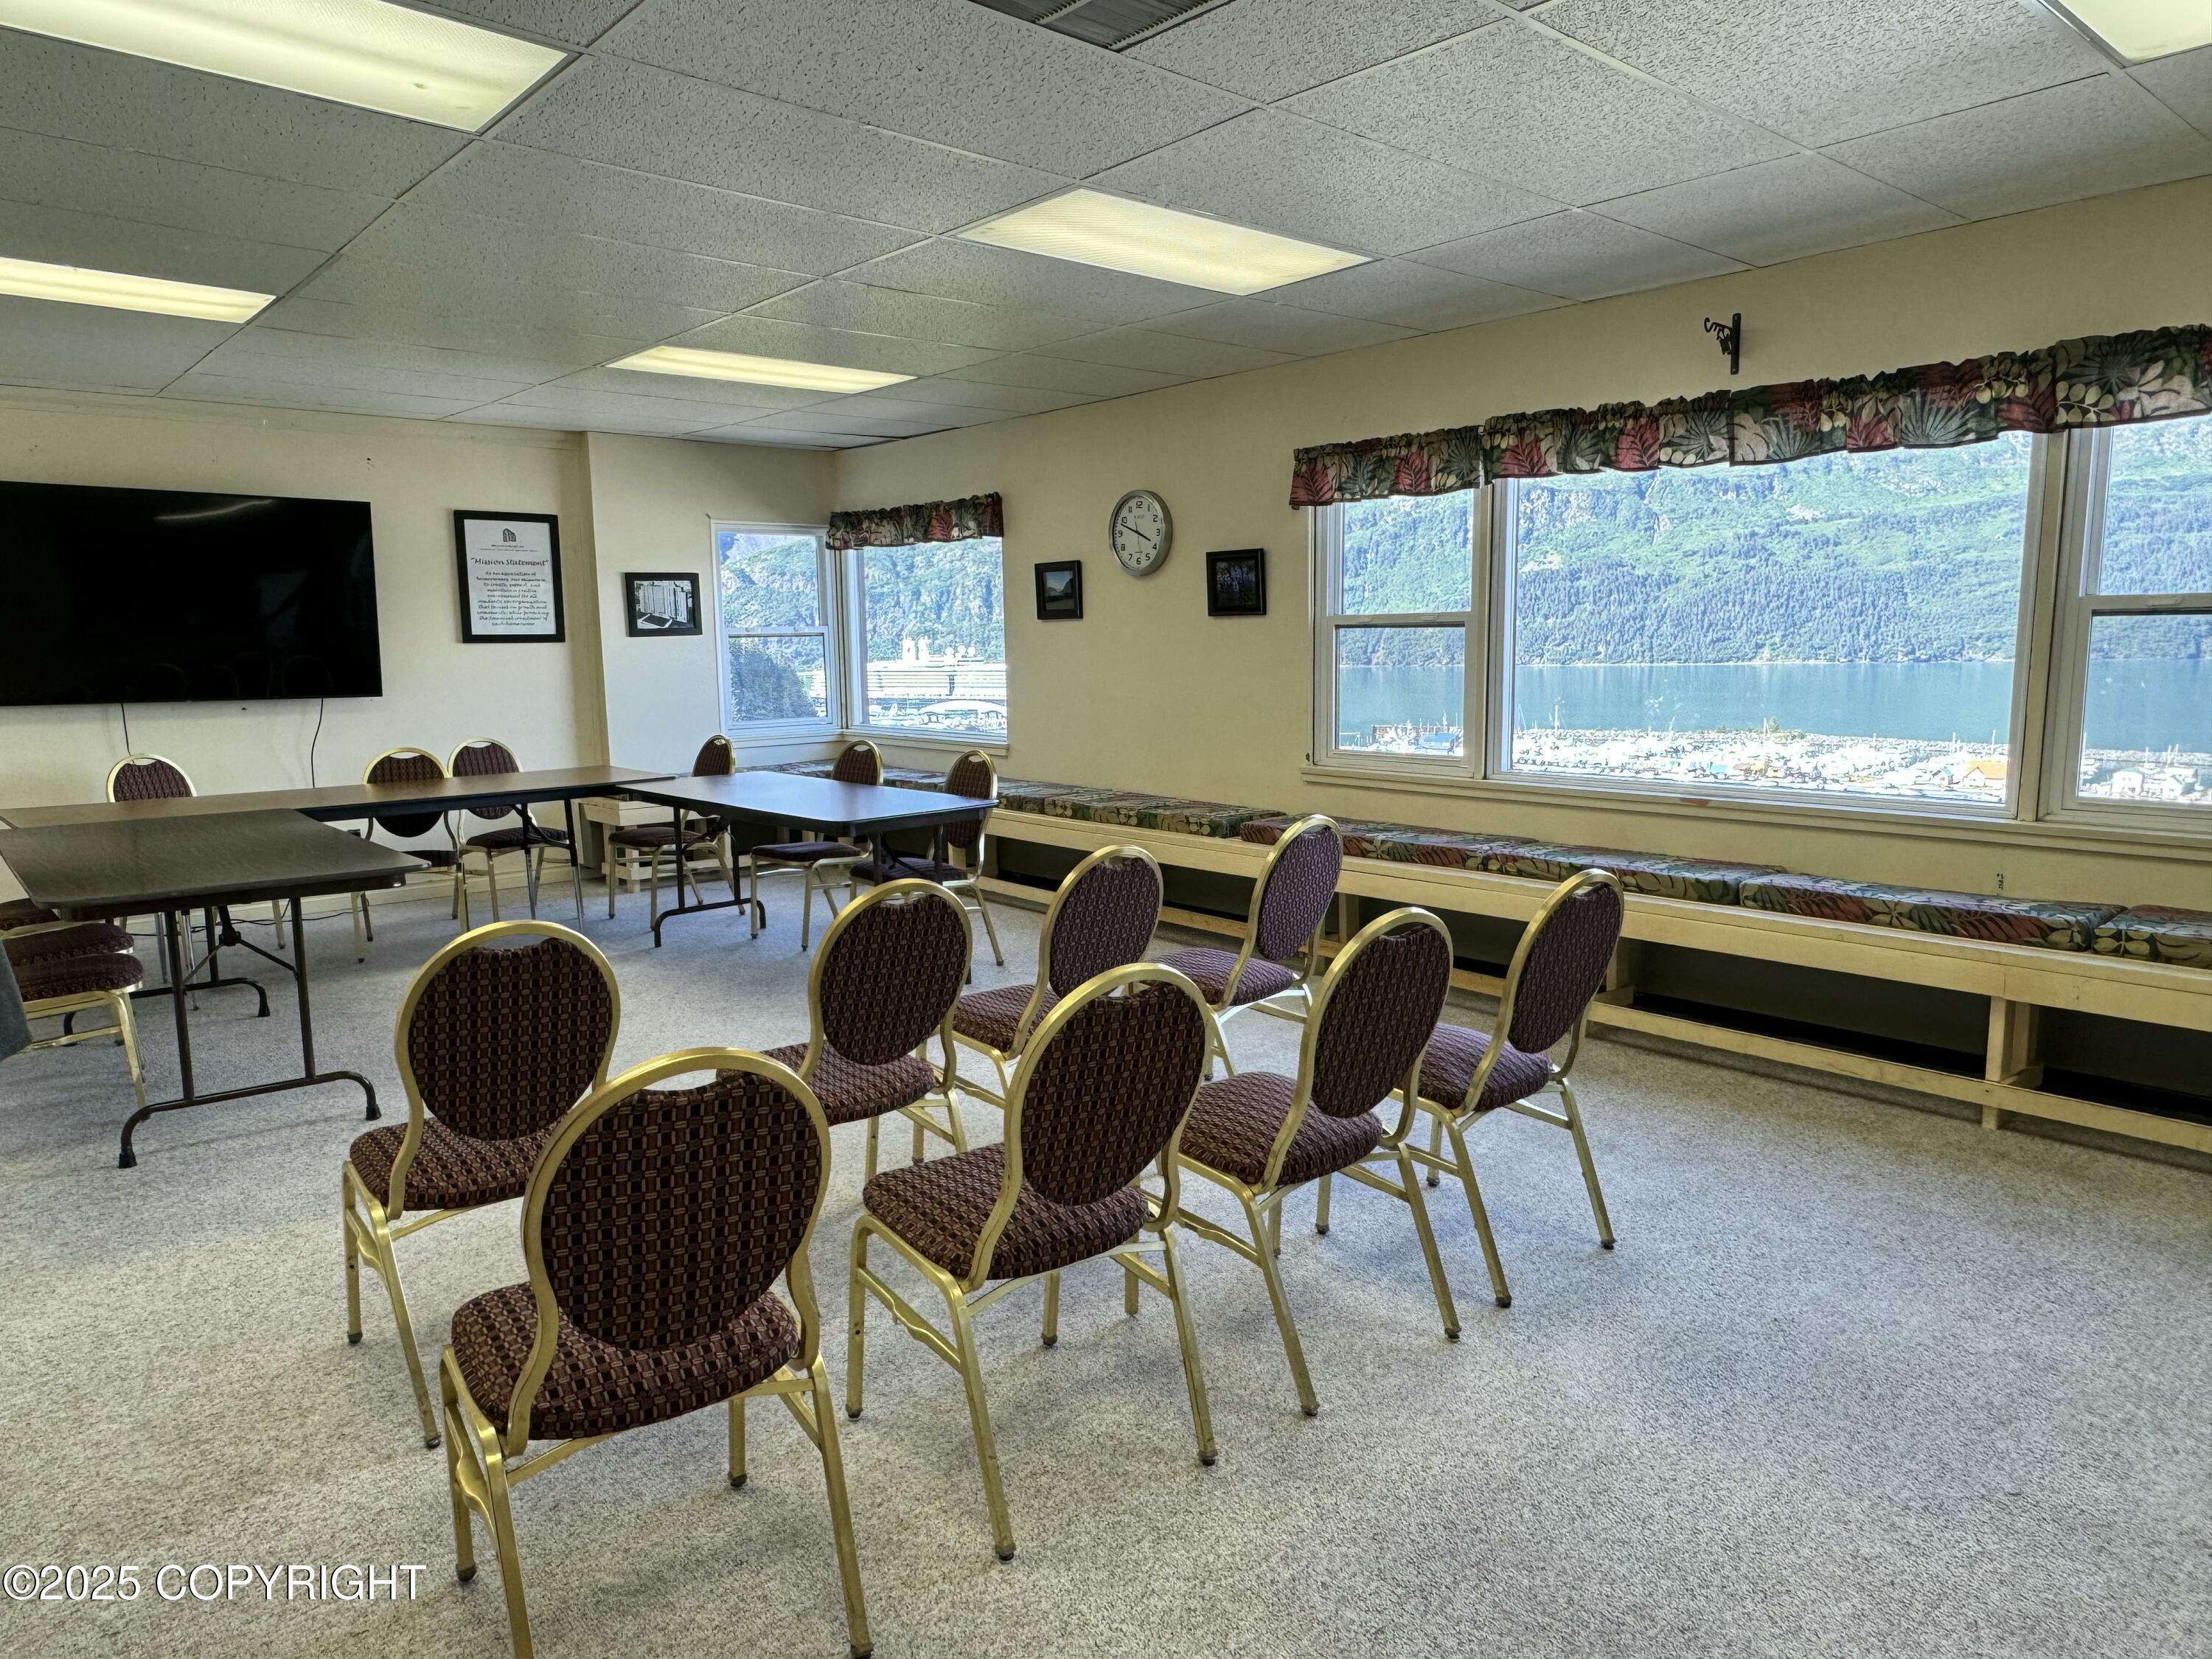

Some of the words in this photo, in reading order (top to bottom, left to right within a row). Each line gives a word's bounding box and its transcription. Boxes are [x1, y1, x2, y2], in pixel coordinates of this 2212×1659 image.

[1135, 501, 1143, 509] 12
[1152, 514, 1158, 523] 2
[1156, 528, 1161, 537] 3
[1120, 543, 1126, 552] 8
[1152, 542, 1157, 550] 4
[1128, 553, 1133, 561] 7
[1145, 552, 1151, 561] 5
[1135, 557, 1141, 566] 6
